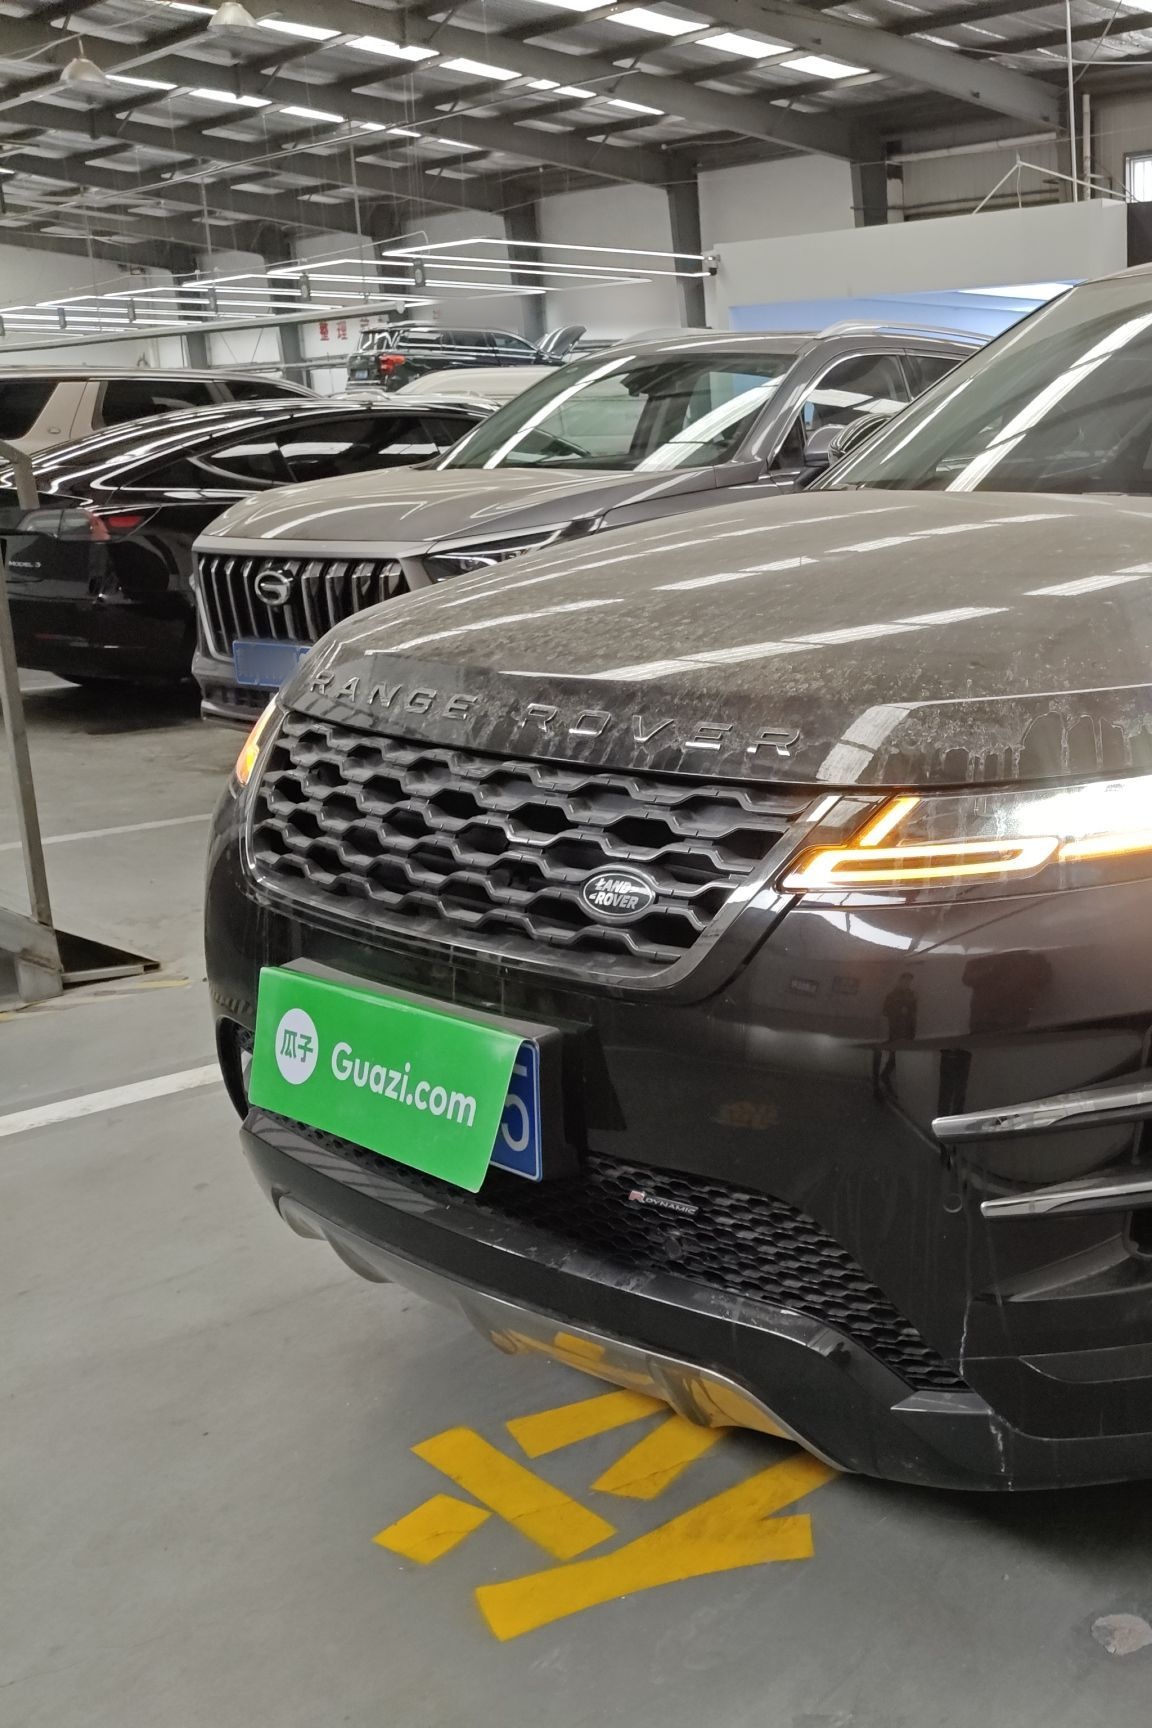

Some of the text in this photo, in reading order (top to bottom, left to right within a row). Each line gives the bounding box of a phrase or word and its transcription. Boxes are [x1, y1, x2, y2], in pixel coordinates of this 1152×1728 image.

[309, 671, 801, 757] RANGE ROVER
[594, 891, 639, 909] ROVER
[595, 878, 632, 893] LAND
[280, 1028, 313, 1063] 瓜子
[331, 1041, 477, 1127] Guazi.com
